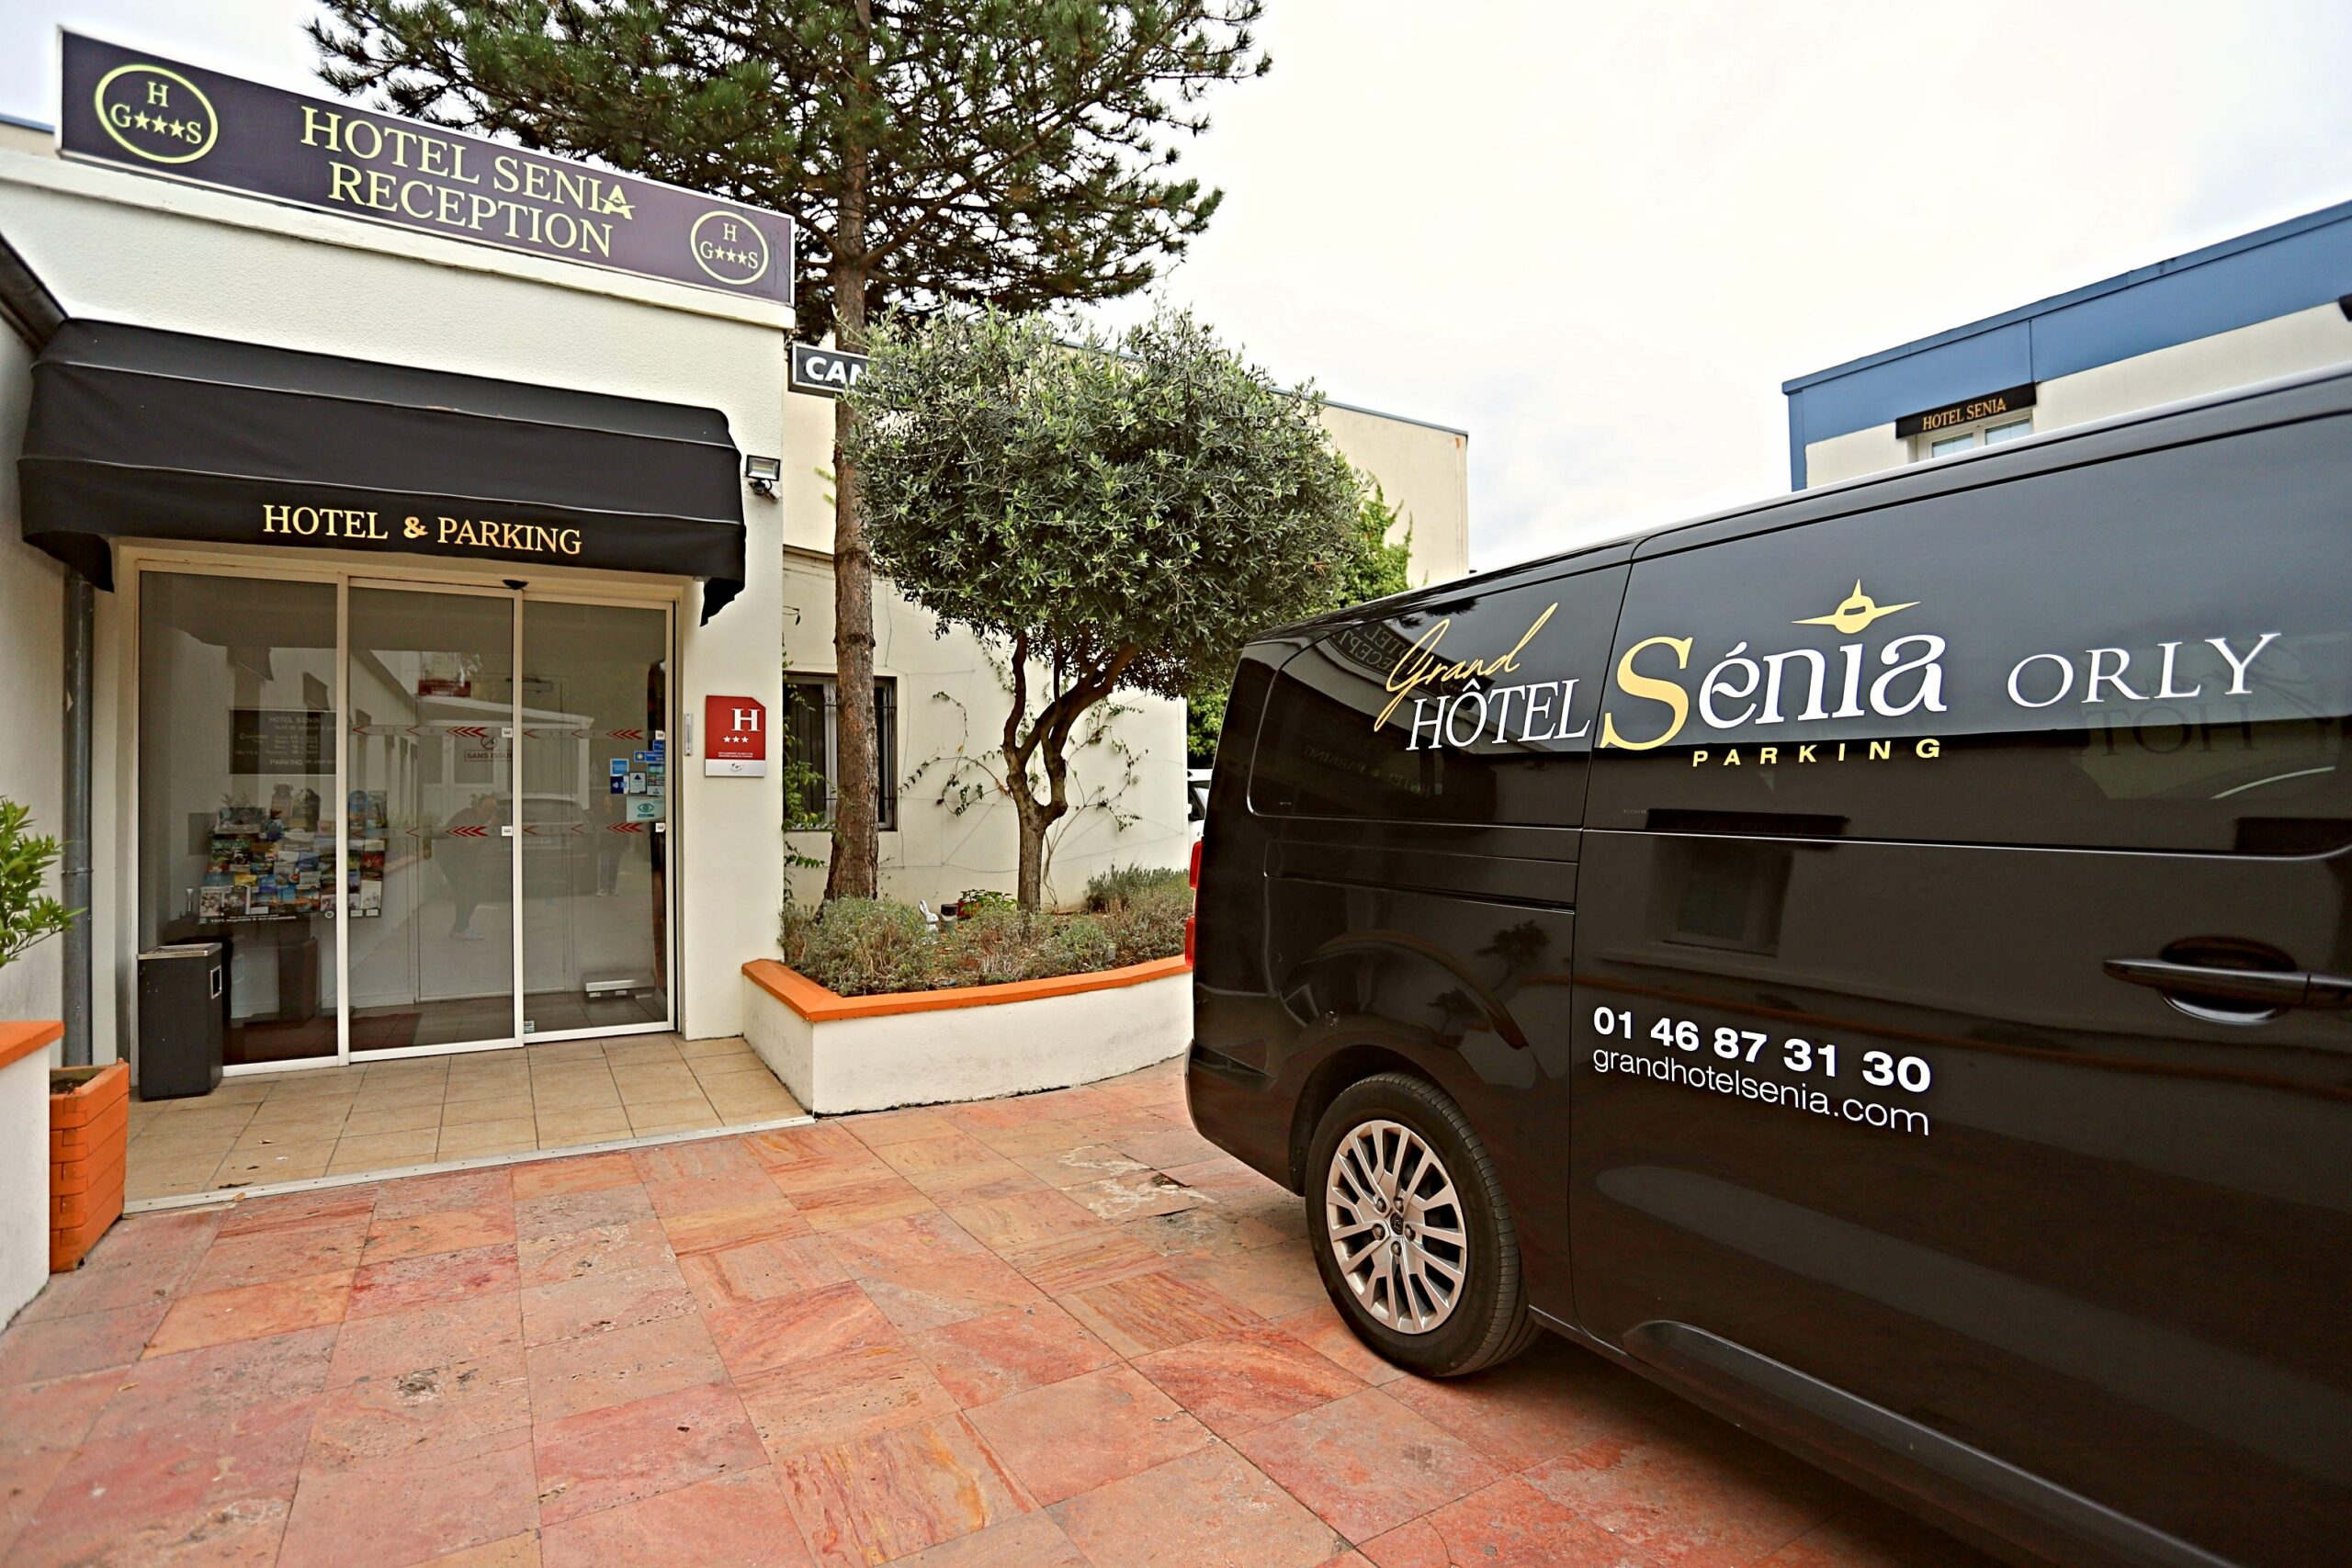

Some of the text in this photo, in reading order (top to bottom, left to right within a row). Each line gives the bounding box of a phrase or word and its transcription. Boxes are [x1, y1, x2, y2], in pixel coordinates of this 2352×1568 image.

[147, 81, 169, 107] H
[300, 106, 637, 220] HOTEL SENIA
[328, 161, 614, 258] RECEPTION
[722, 222, 738, 243] H
[1922, 398, 2007, 431] HOTEL SENIA
[263, 504, 582, 555] HOTEL & PARKING
[1374, 602, 1559, 733] Grand
[1405, 632, 2282, 751] HÔTEL Sénia ORLY
[730, 707, 761, 732] H
[1692, 738, 1941, 768] PARKING
[1593, 1006, 1931, 1093] 01 46 87 31 30
[1593, 1049, 1929, 1136] grandhotelsenia.com
